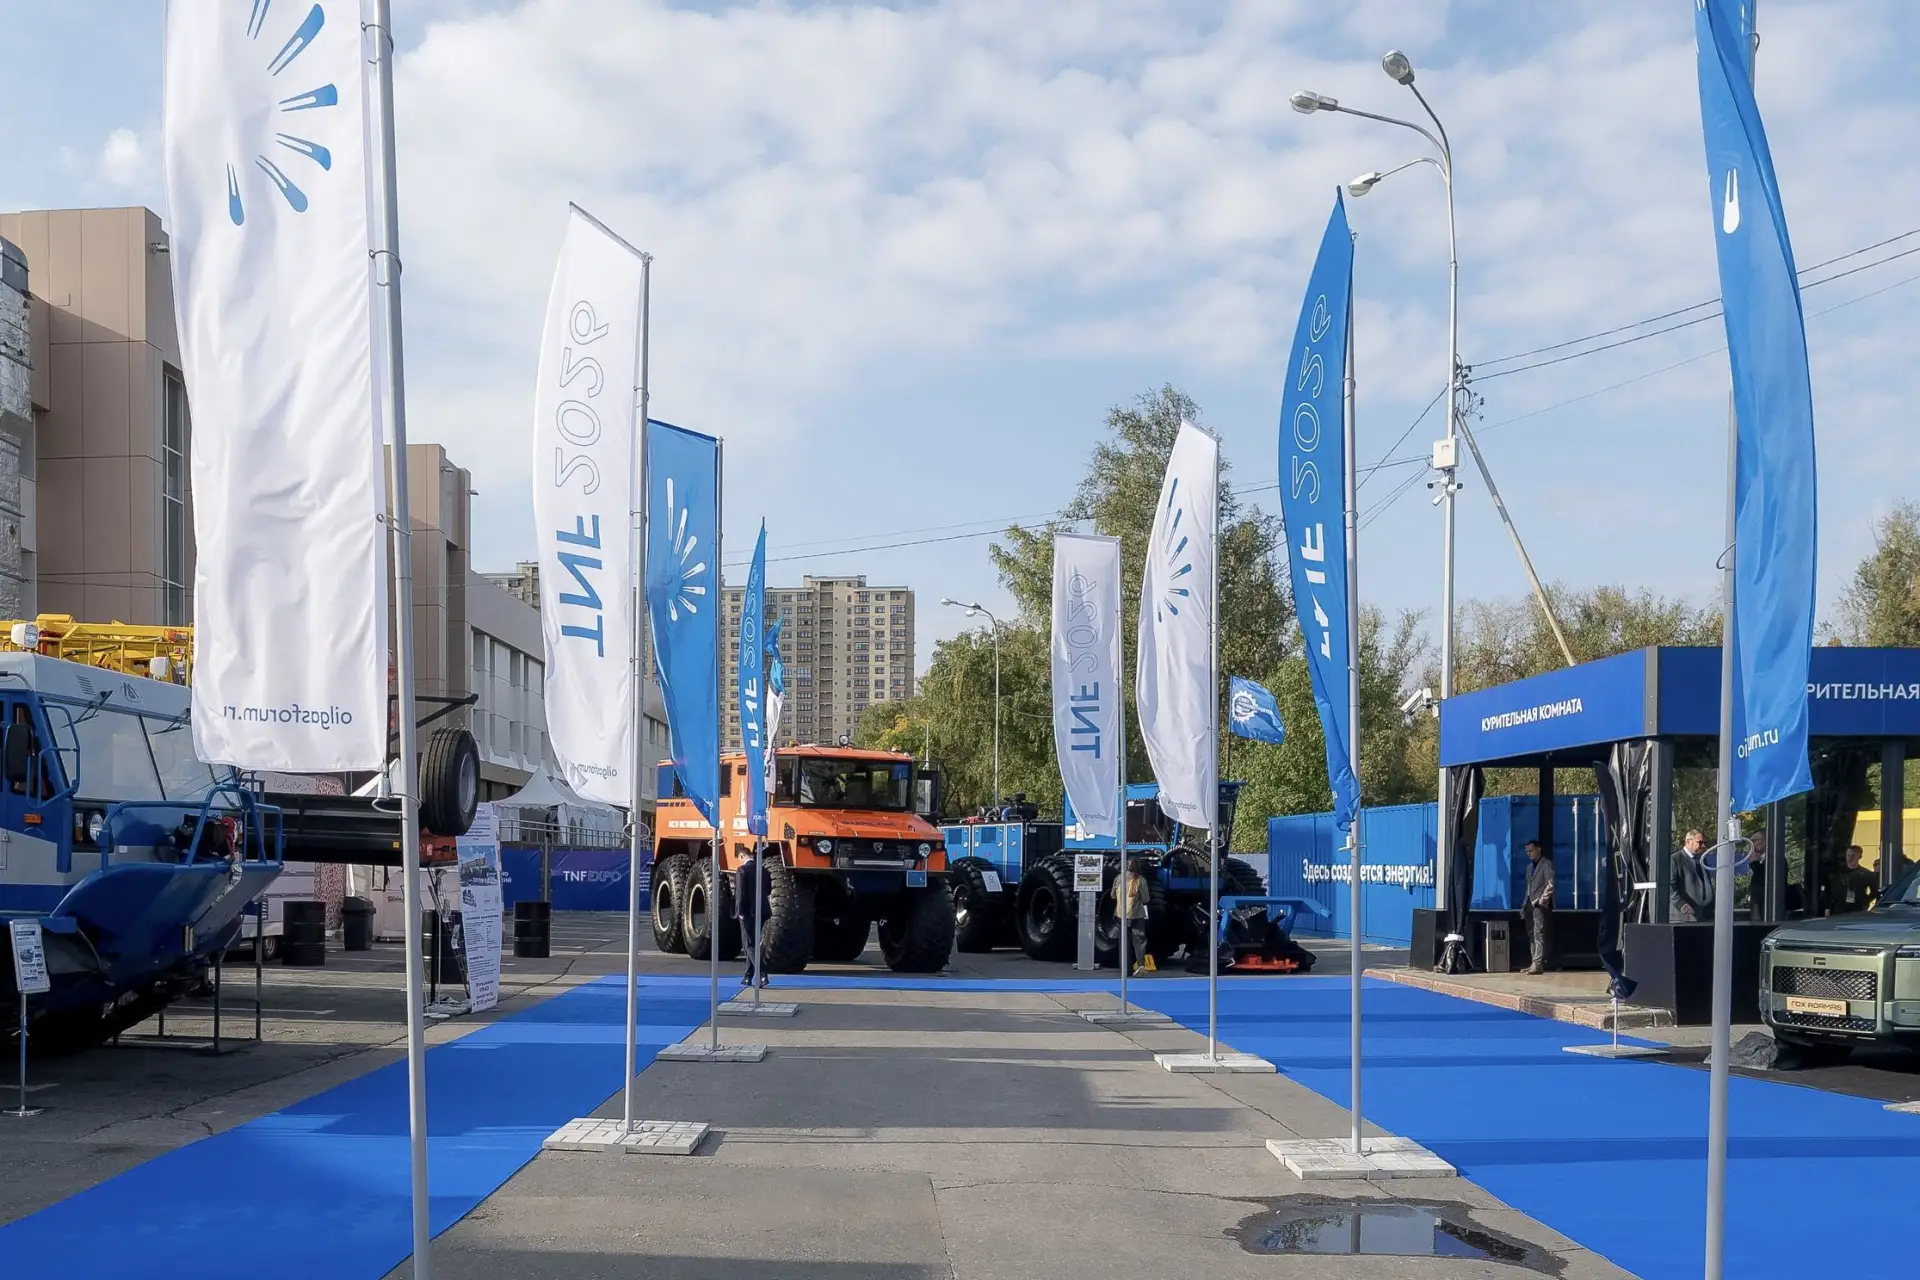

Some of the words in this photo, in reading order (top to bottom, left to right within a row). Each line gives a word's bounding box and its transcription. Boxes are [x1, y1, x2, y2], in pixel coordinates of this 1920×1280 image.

[1806, 683, 1920, 700] РИТЕЛЬНАЯ
[1481, 707, 1539, 732] КУРИТЕЛЬНАЯ
[1539, 698, 1583, 721] КОМНАТА
[1302, 858, 1330, 883] Здесь
[1331, 862, 1383, 886] создется
[1385, 858, 1434, 890] энергия!
